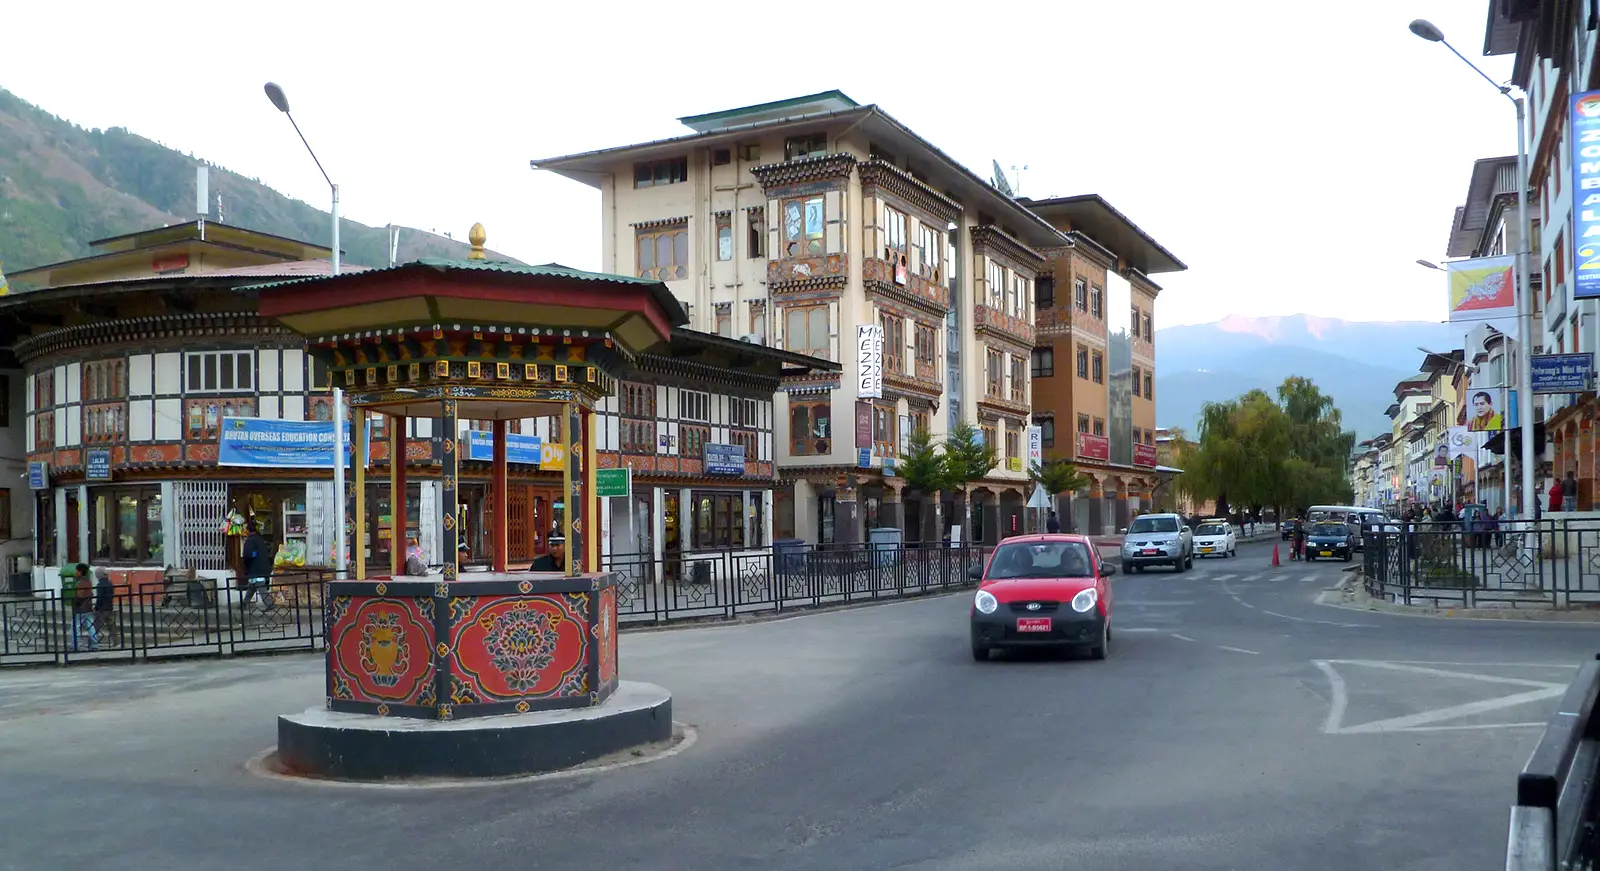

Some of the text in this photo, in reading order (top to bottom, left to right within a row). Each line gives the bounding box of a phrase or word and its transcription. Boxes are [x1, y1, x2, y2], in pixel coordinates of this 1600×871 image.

[1578, 241, 1600, 270] 2
[859, 327, 872, 389] MEZZE
[874, 327, 883, 389] MEZZE
[224, 430, 249, 440] BHUTAN
[250, 431, 281, 442] OVERSEAS
[281, 432, 317, 442] EDUCATION
